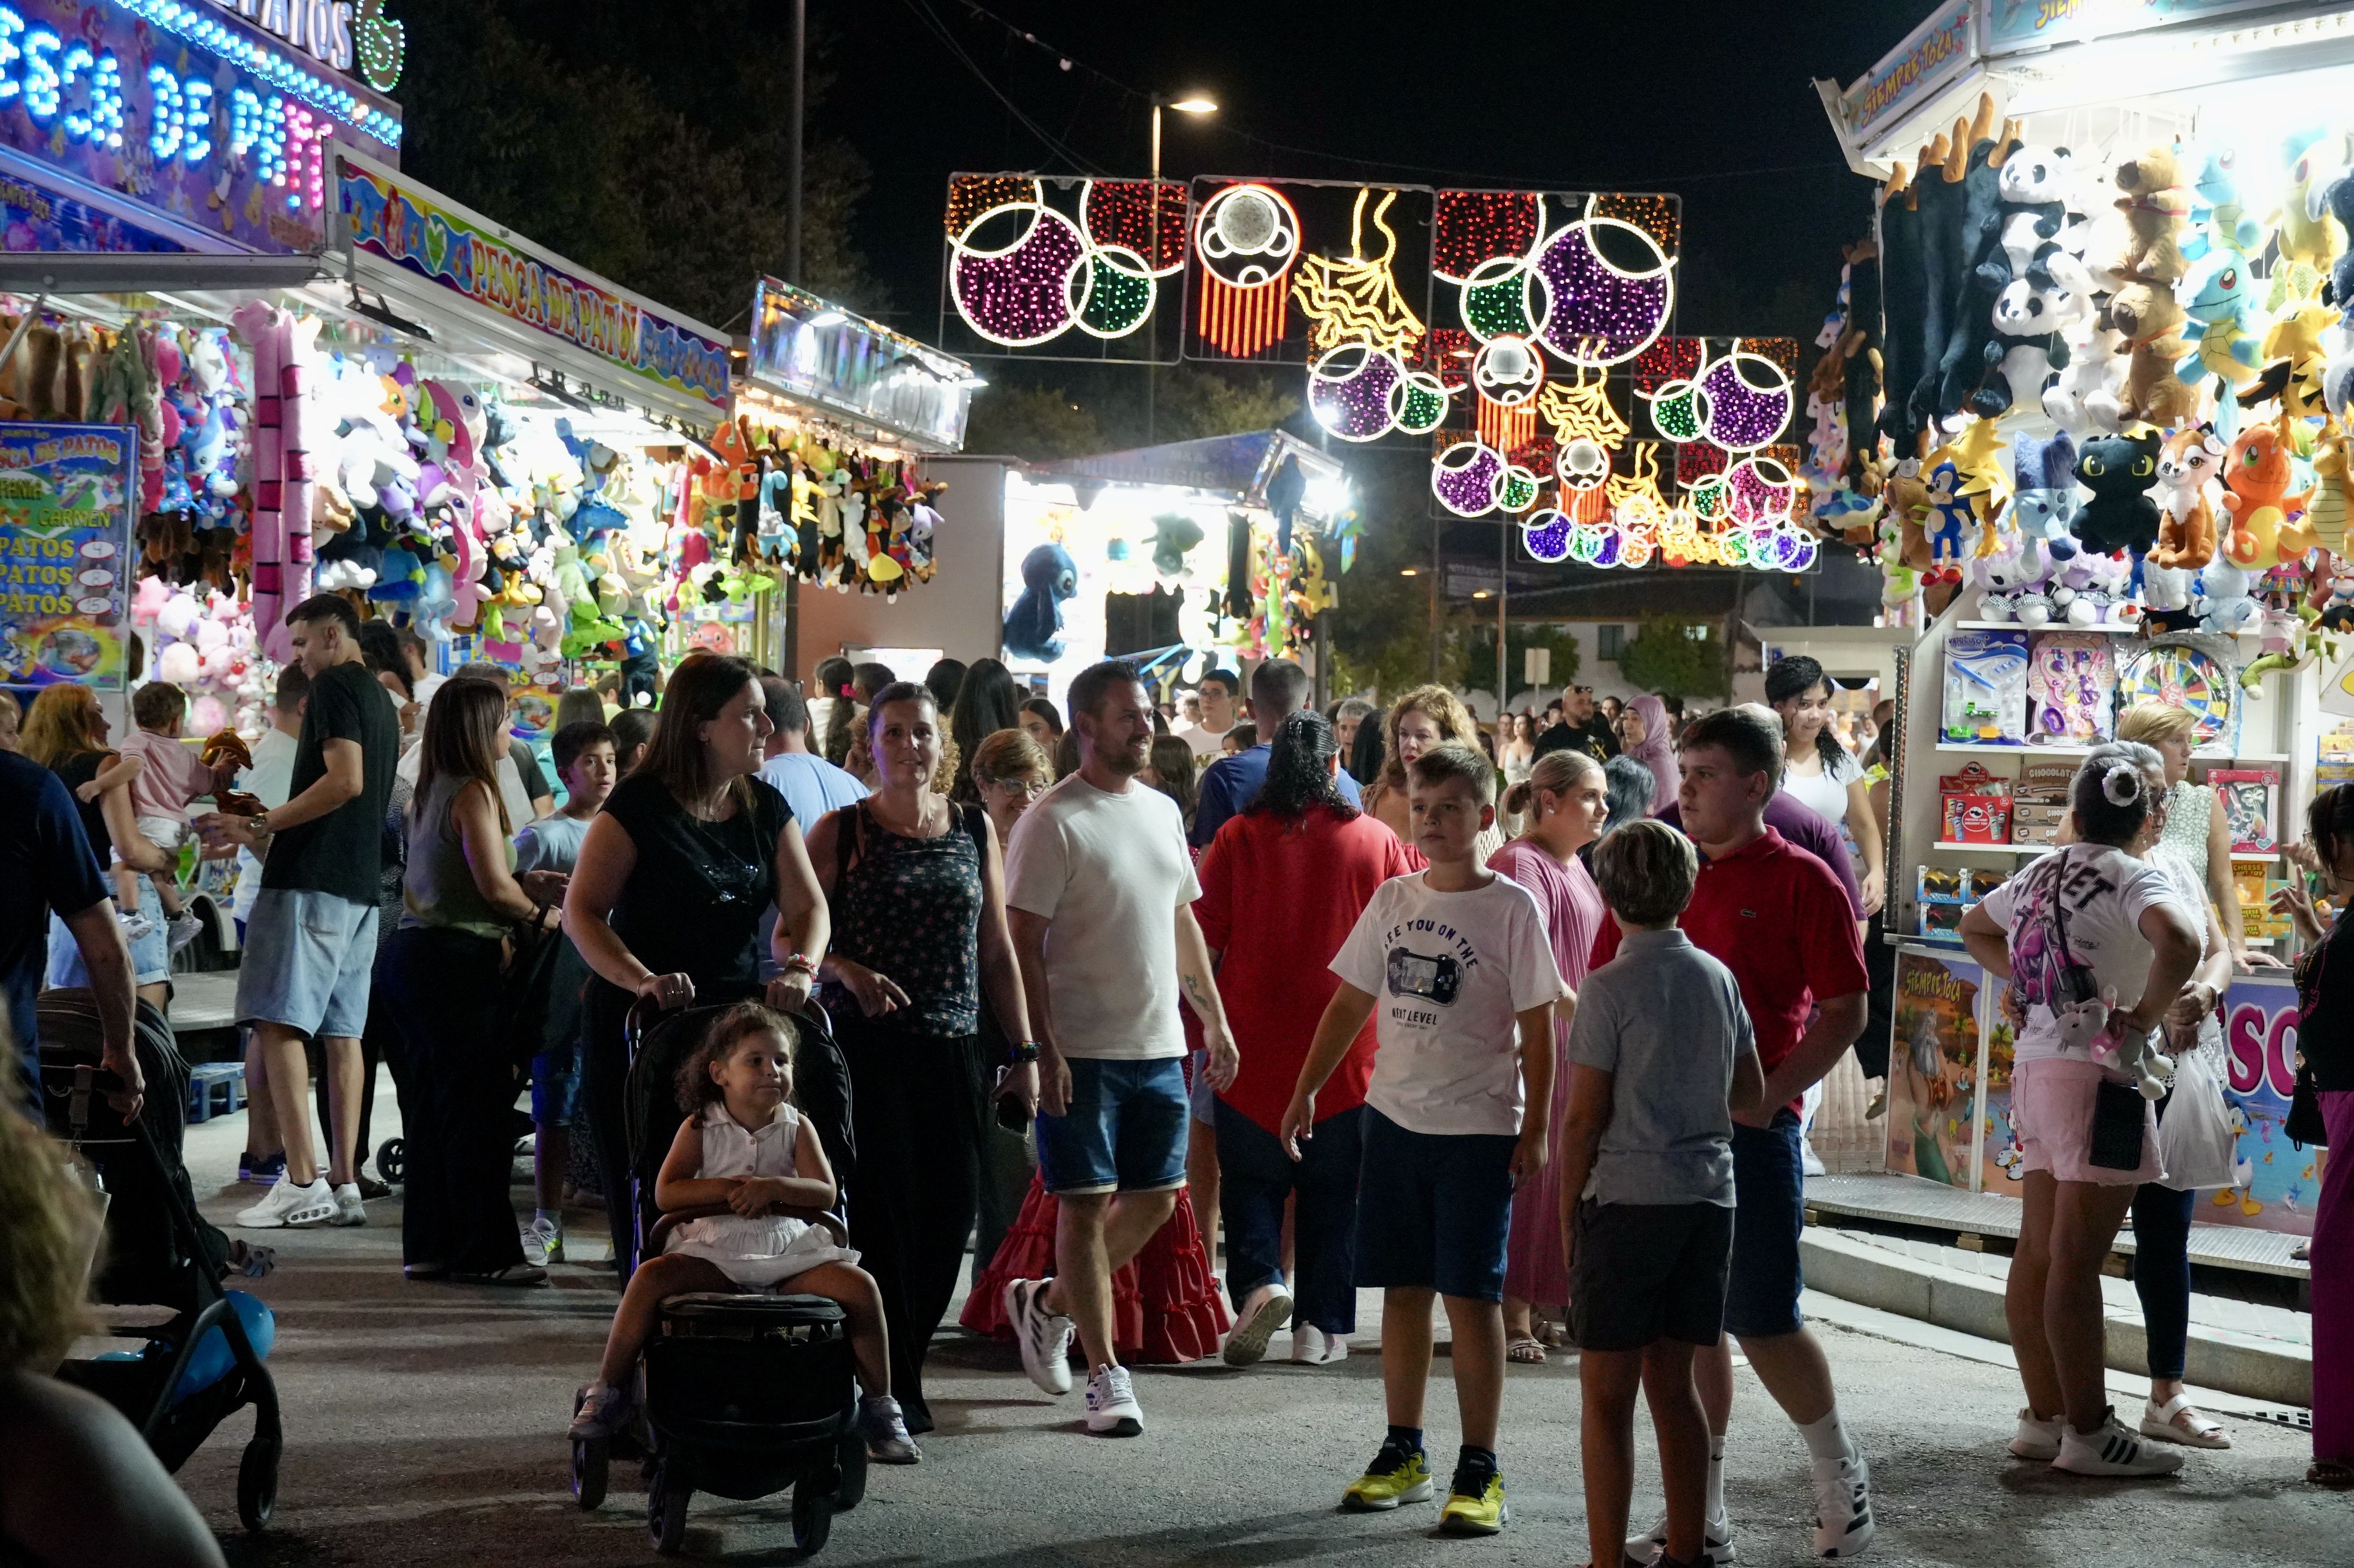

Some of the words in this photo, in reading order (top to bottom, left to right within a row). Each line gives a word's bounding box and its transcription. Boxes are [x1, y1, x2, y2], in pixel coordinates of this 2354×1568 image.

[1862, 52, 1921, 129] SIEMPRE
[1922, 28, 1953, 71] TOCA
[148, 63, 212, 161] DE
[471, 238, 543, 323] PESCA
[547, 276, 575, 337] DE
[579, 292, 640, 366] PATOS
[34, 440, 59, 464] DE
[62, 436, 119, 464] PATOS
[39, 509, 111, 528] CARMEN
[92, 545, 103, 556] 4
[91, 570, 101, 584] 8
[1406, 919, 1435, 932] YOU
[1438, 924, 1456, 940] ON
[1456, 937, 1479, 969] THE
[1904, 969, 1941, 997] SIEMPRE
[1943, 971, 1961, 1002] TOCA
[1392, 1007, 1407, 1020] NEXT
[1407, 1010, 1437, 1025] LEVEL
